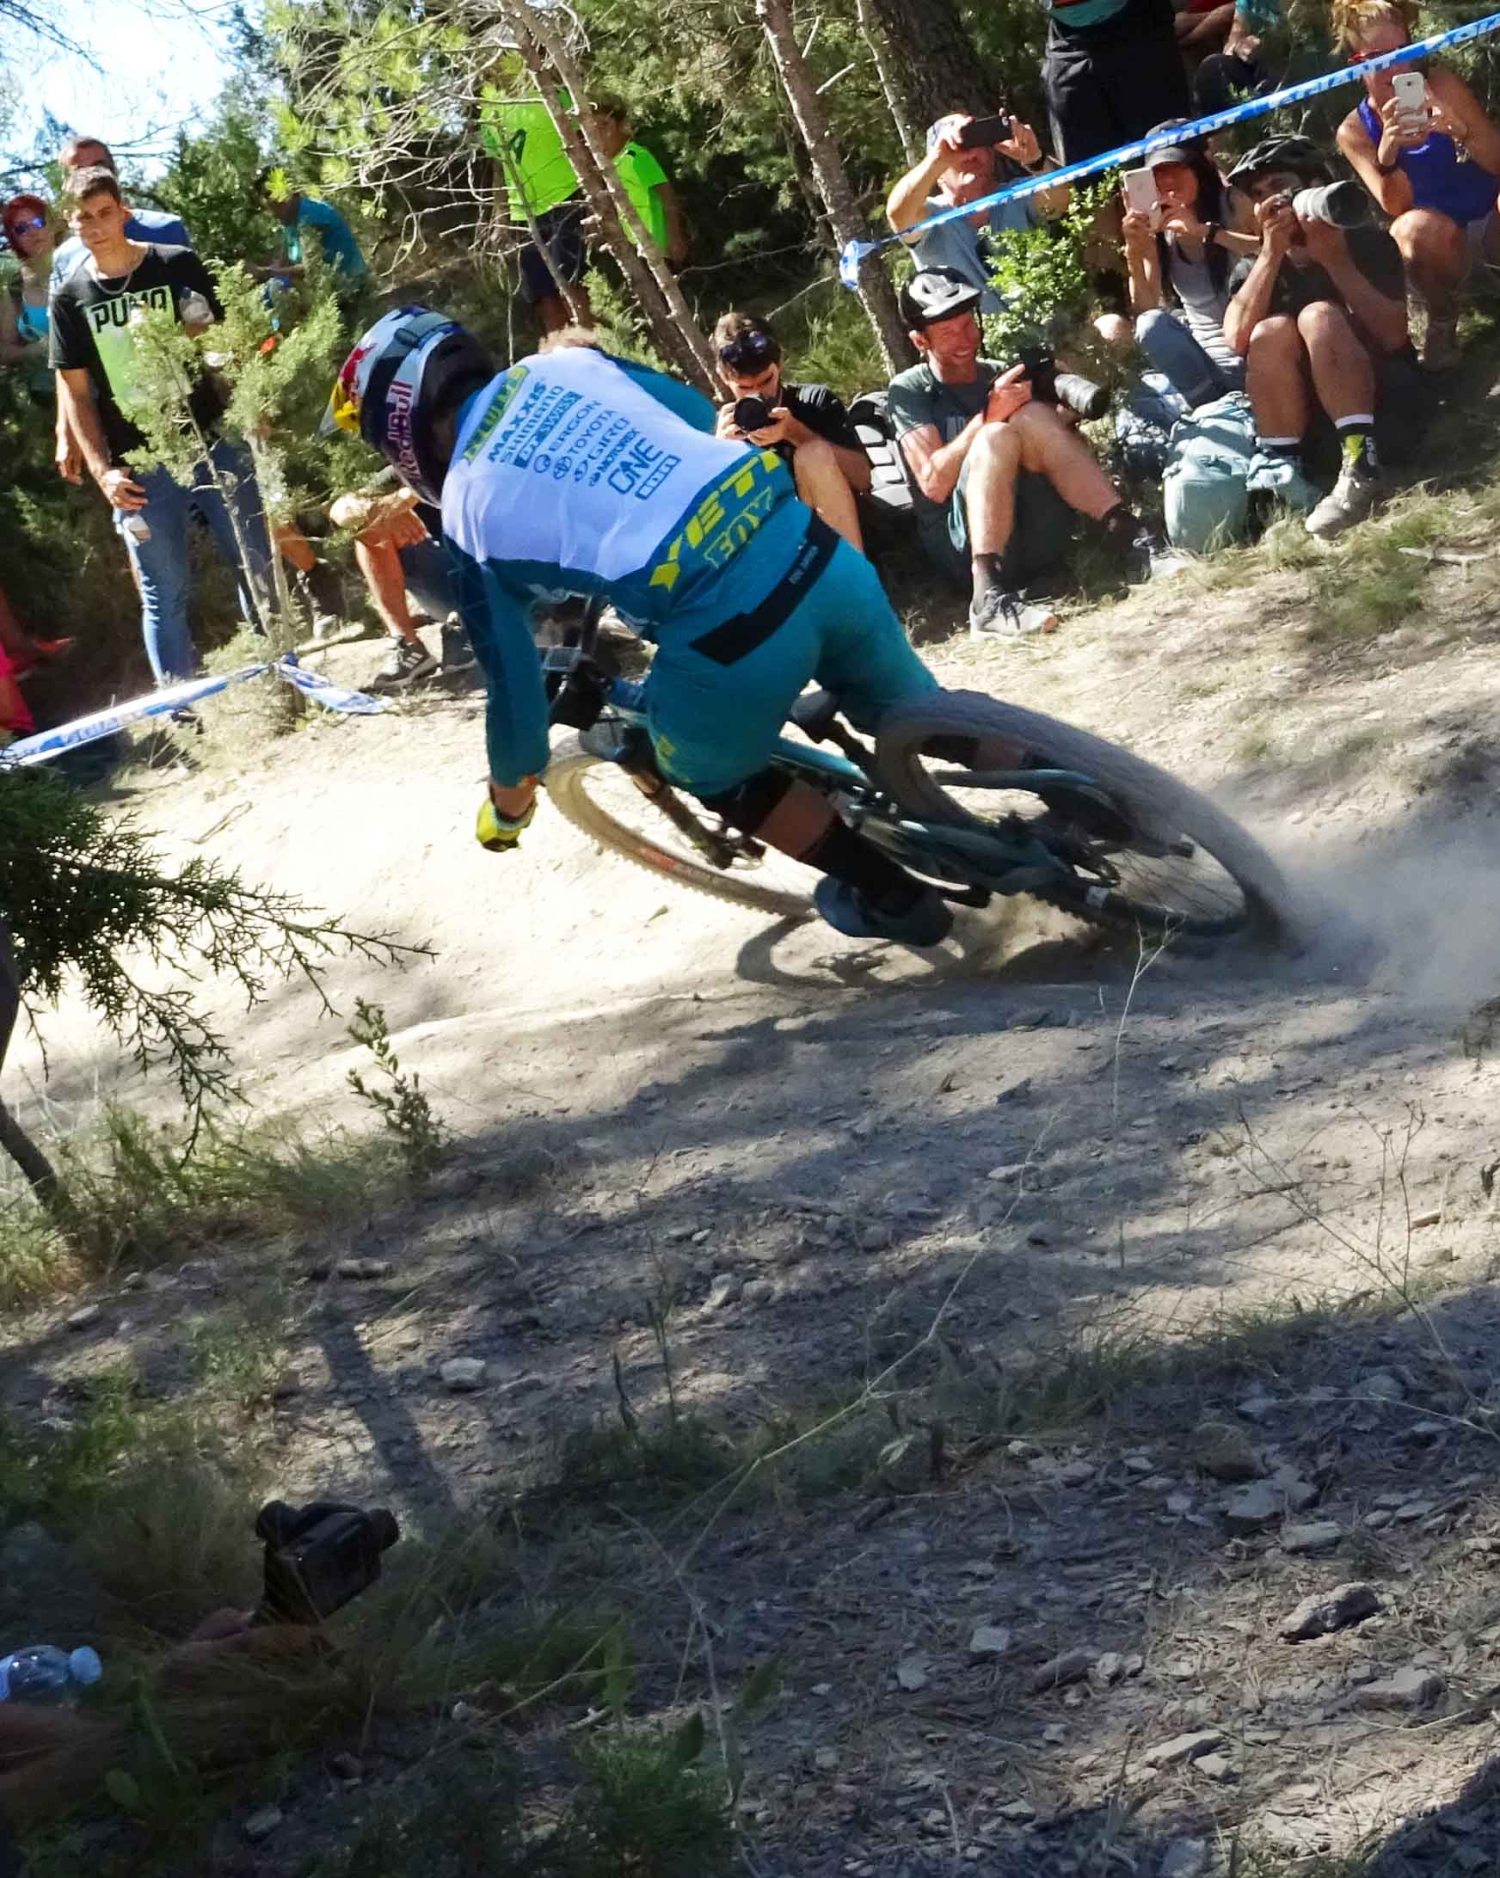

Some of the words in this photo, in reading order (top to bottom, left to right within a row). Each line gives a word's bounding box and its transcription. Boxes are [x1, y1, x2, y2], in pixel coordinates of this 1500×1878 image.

[488, 381, 546, 463] MAXXIS
[499, 385, 564, 464] SHIMANO
[548, 400, 603, 452] ERGON
[569, 408, 618, 455] TOYOTA
[587, 416, 630, 461] GIRO
[597, 427, 642, 473] MOTOREX
[649, 447, 781, 593] YETI
